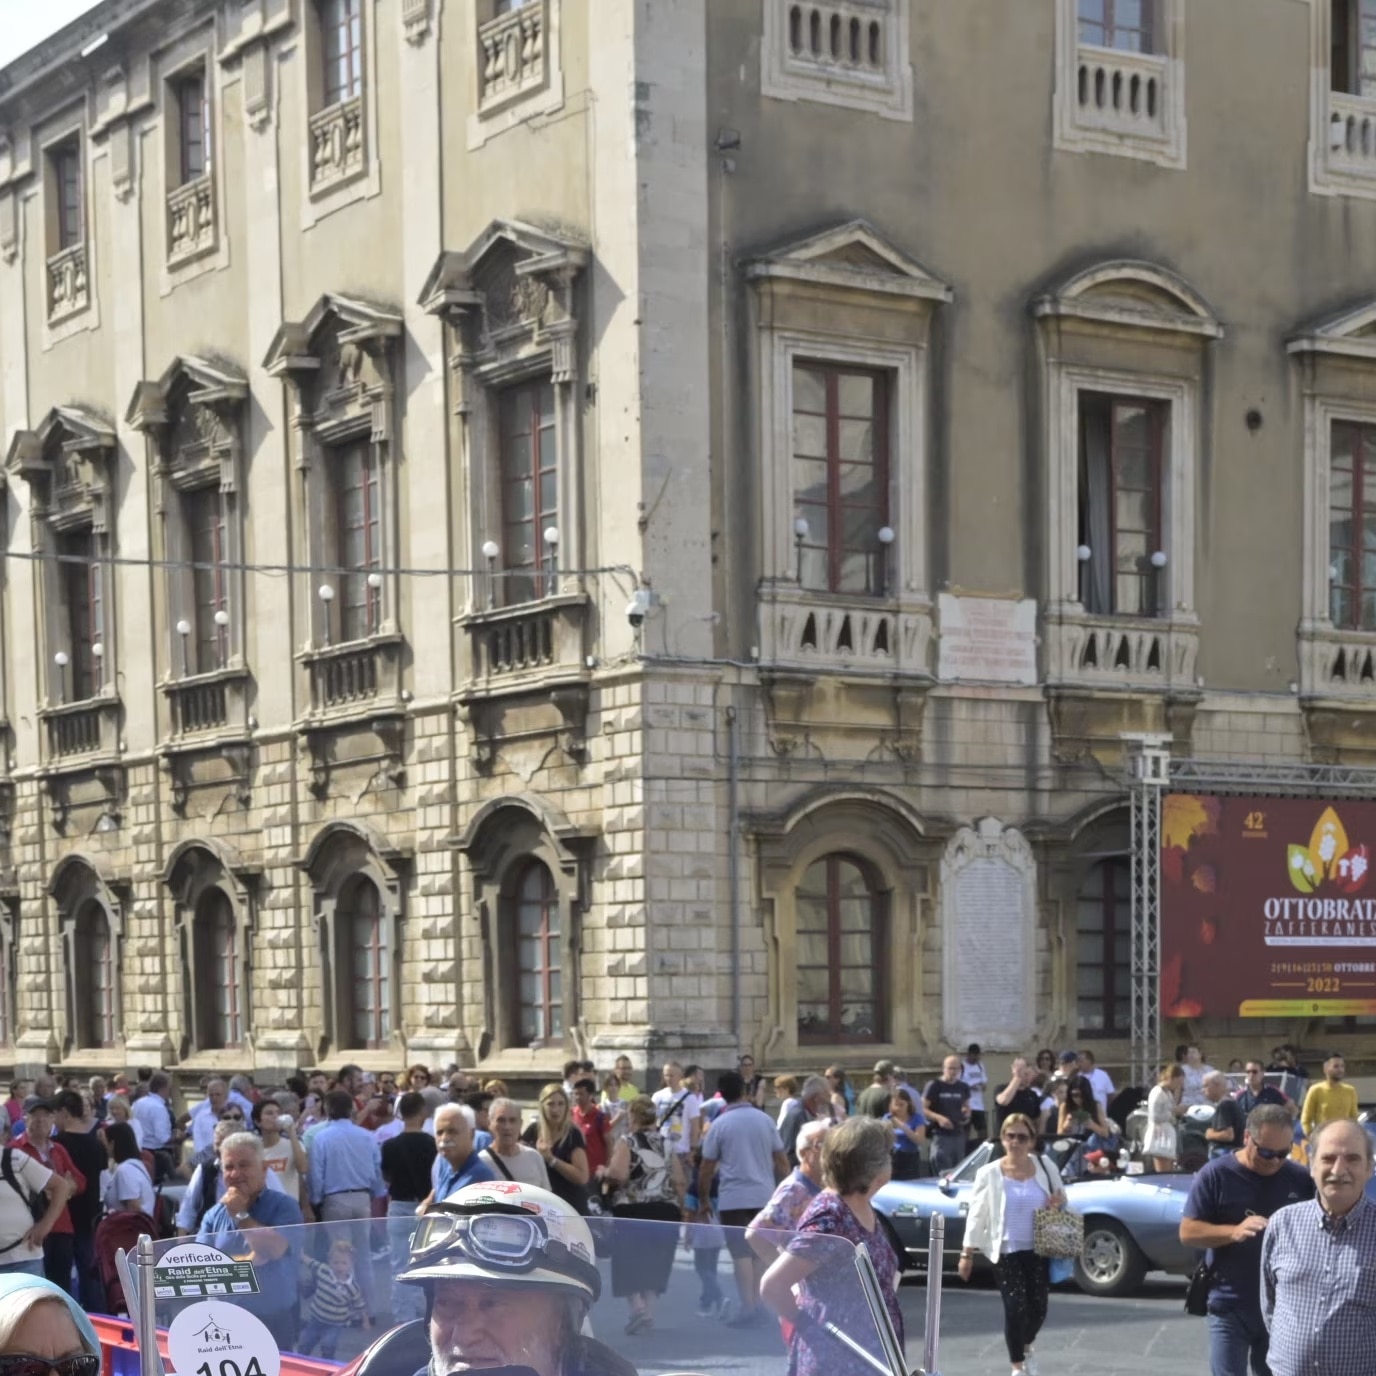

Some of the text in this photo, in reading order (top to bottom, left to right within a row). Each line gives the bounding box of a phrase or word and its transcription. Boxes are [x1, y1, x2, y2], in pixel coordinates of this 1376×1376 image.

[1333, 962, 1376, 973] OTTOBRE
[1306, 977, 1340, 993] 2022
[165, 1252, 223, 1264] verificato
[167, 1267, 192, 1276] Raid
